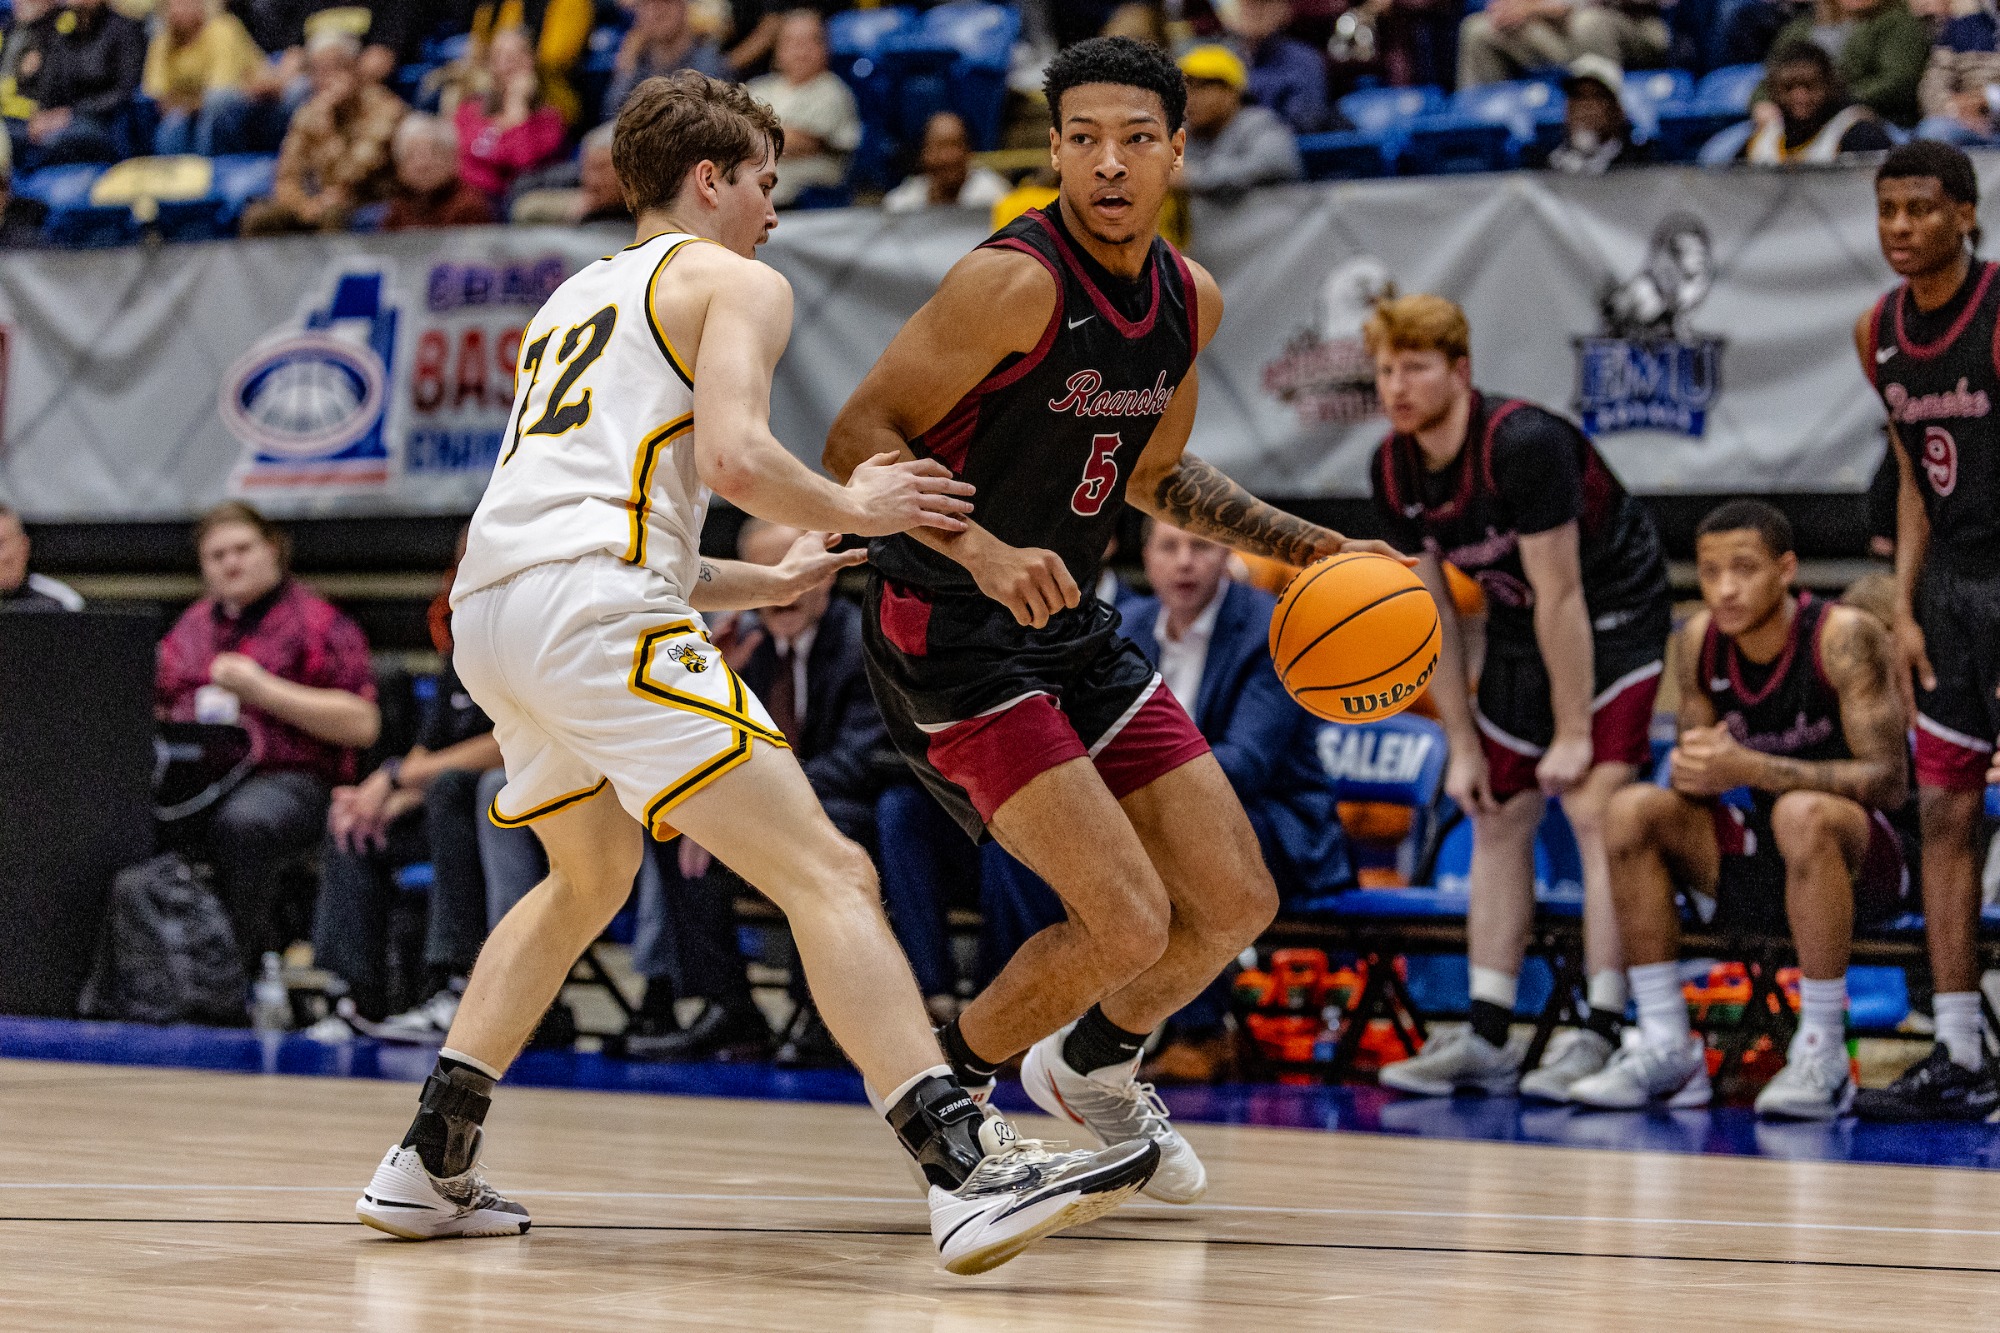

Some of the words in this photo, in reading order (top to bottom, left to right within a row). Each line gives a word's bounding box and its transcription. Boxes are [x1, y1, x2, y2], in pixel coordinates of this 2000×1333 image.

[501, 303, 618, 468] 12
[1071, 432, 1123, 516] 5
[1921, 426, 1958, 497] 9
[1340, 653, 1437, 715] Wilson
